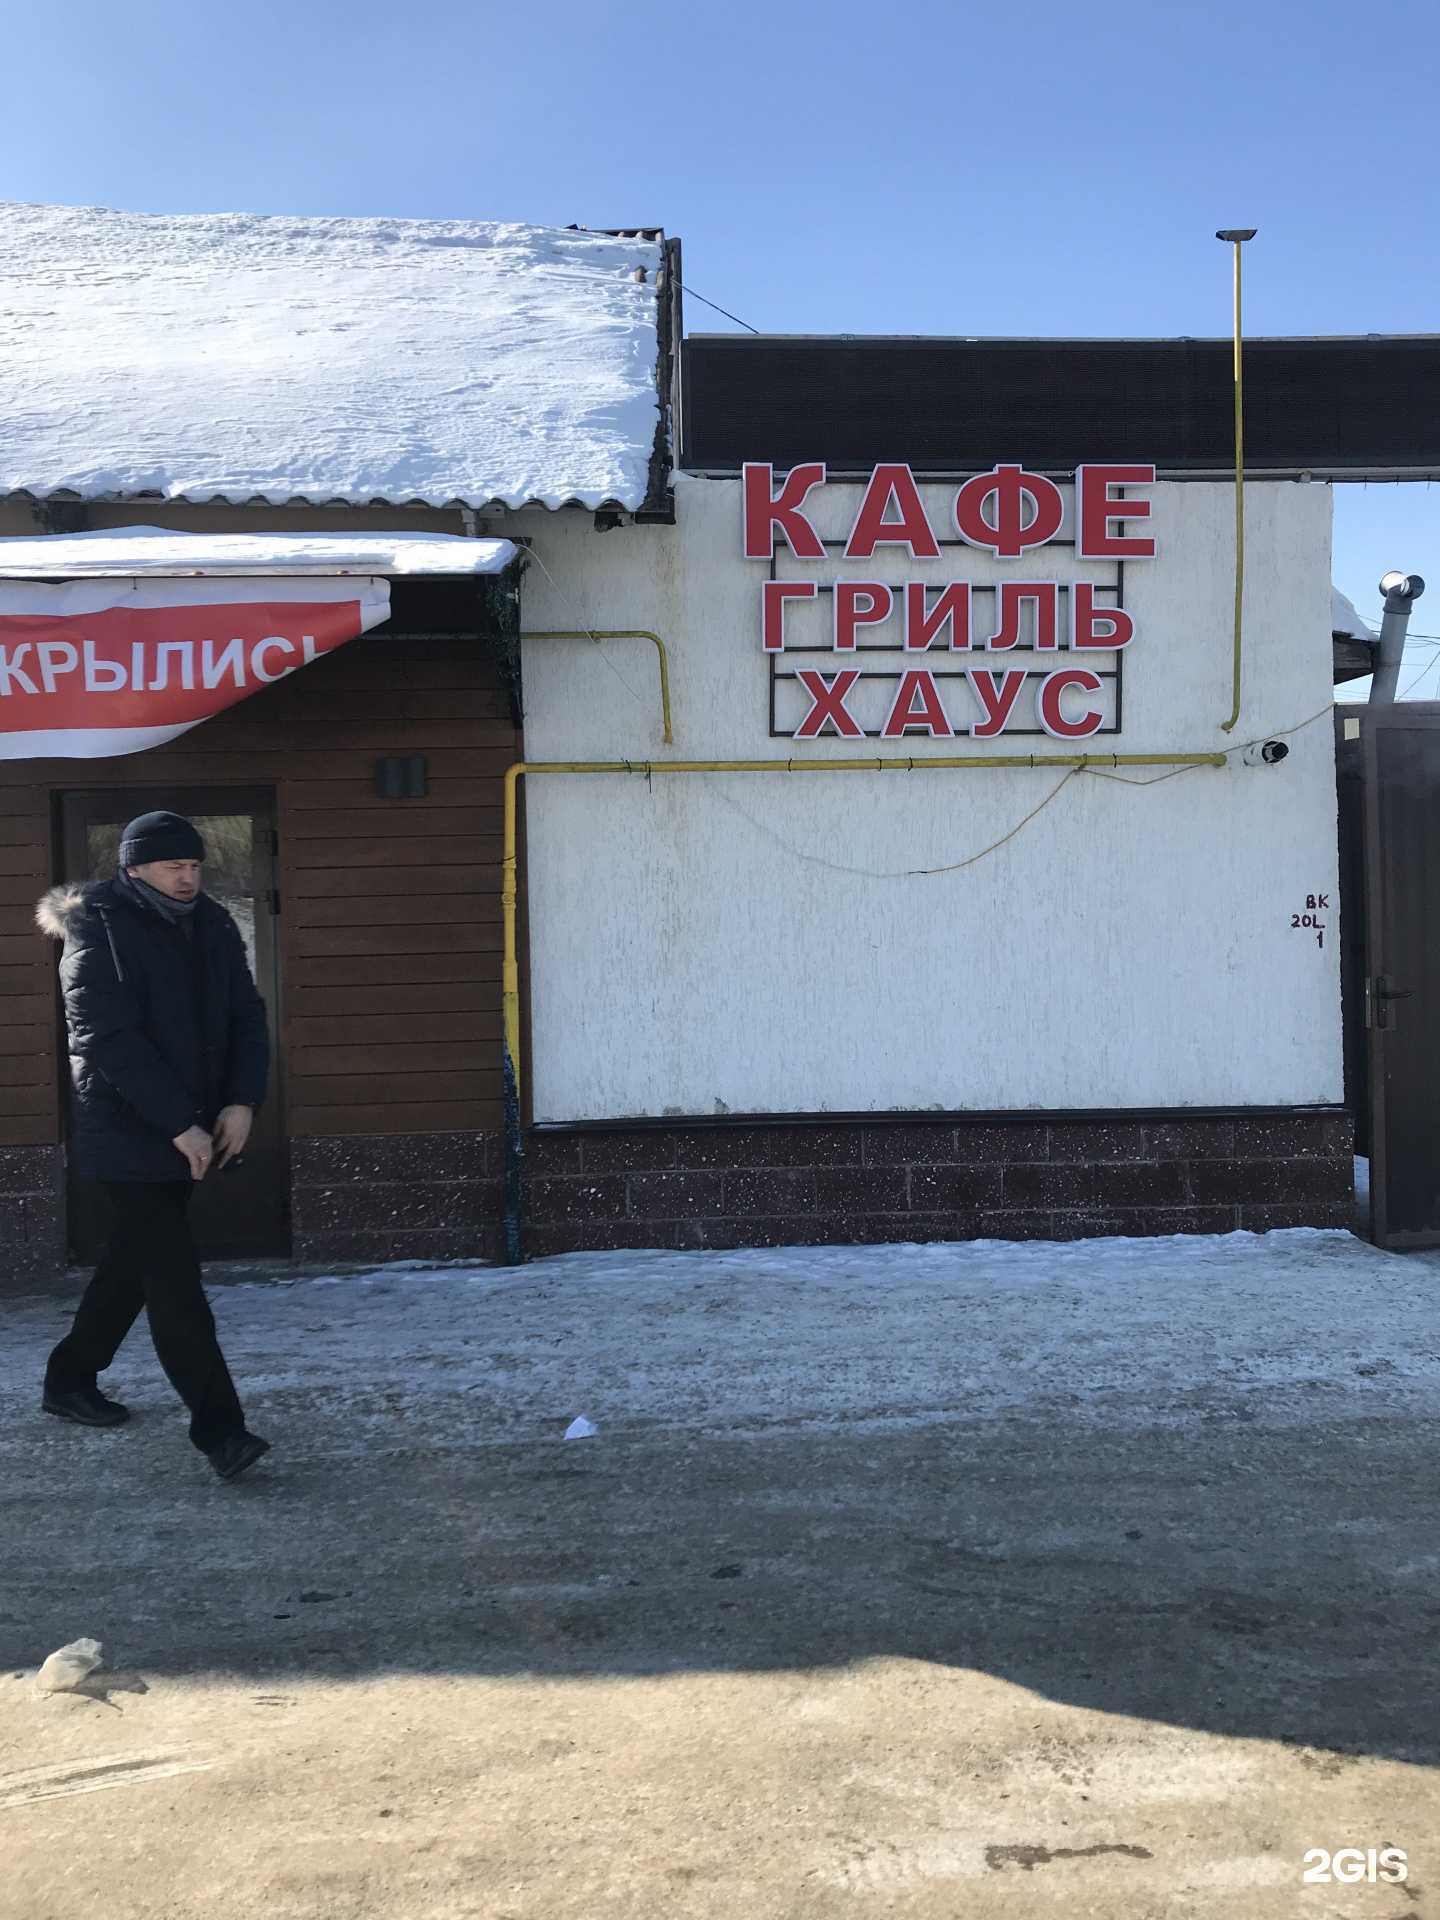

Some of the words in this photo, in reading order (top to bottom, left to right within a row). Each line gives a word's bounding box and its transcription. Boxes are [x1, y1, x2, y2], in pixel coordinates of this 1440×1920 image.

[743, 462, 1157, 560] КАФЕ
[762, 580, 1136, 652] ГРИЛЬ
[793, 667, 1105, 739] ХАУС
